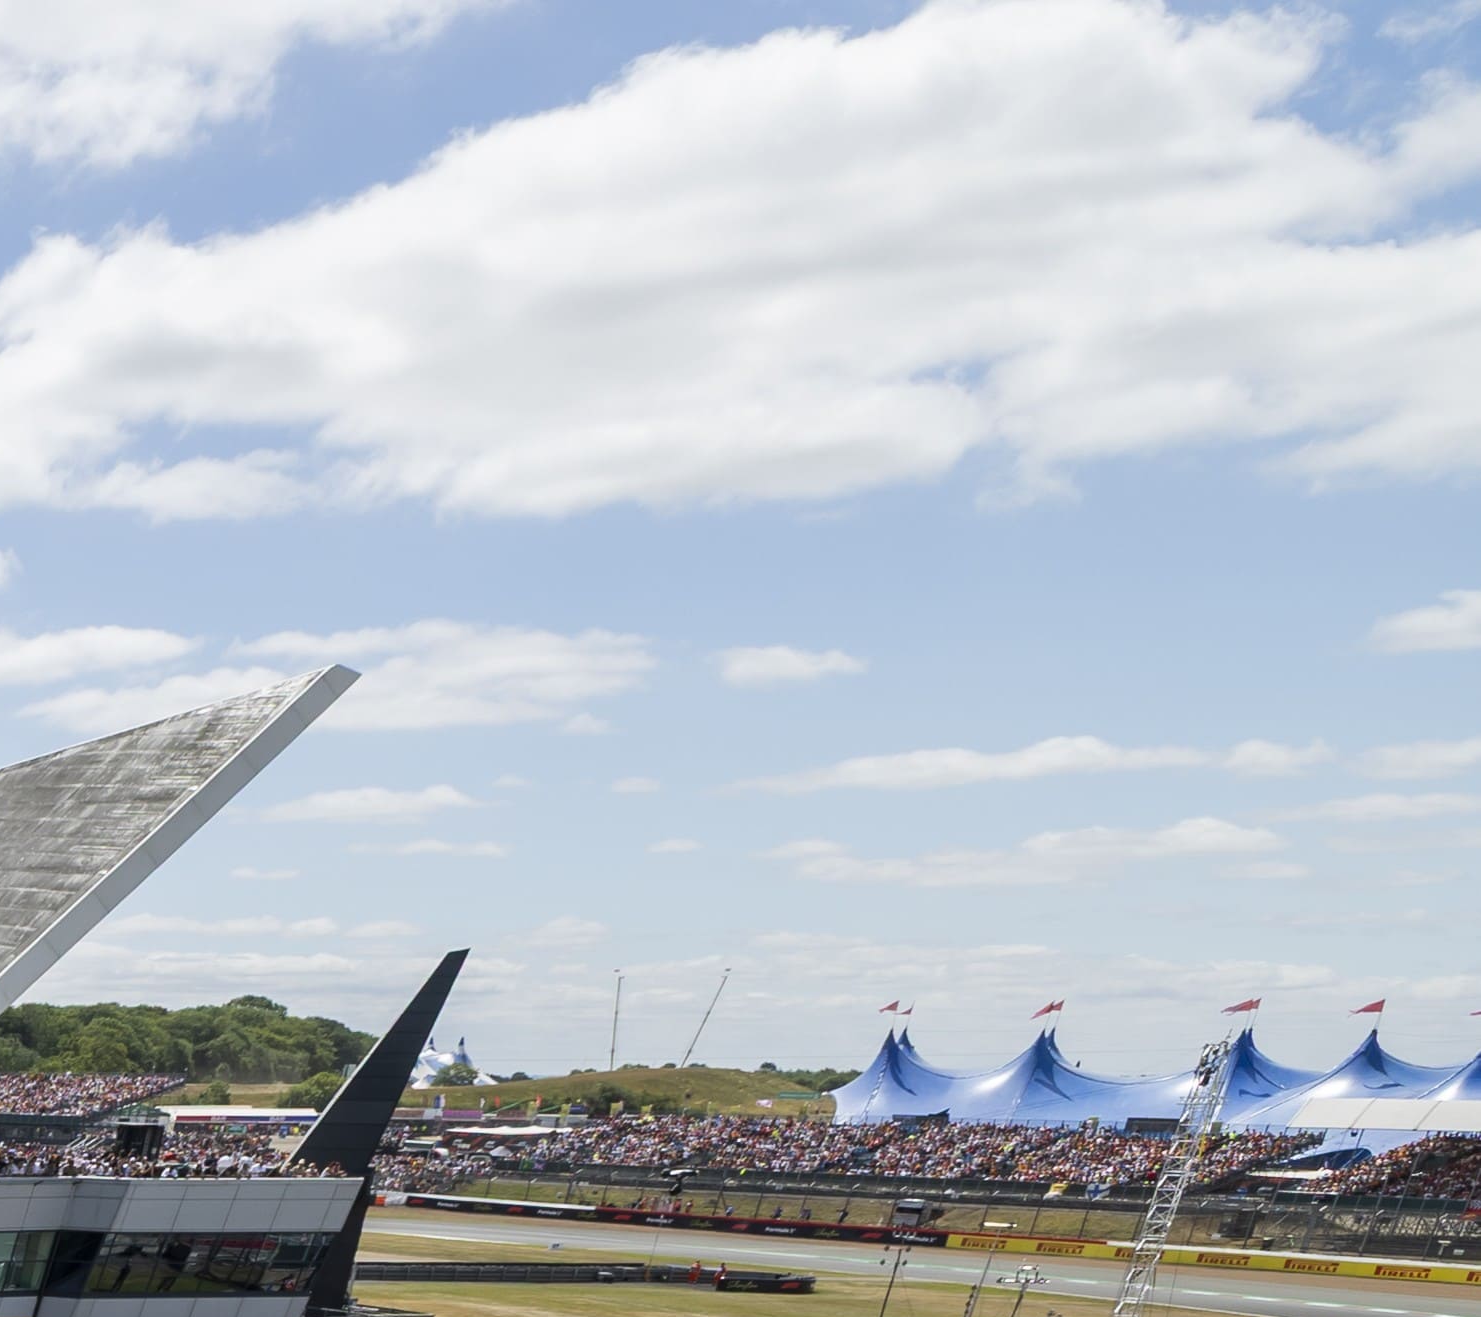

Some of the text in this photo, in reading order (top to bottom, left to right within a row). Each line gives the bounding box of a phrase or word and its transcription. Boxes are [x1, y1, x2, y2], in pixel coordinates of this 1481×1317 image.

[960, 1237, 1007, 1249] PIRELLI
[1036, 1242, 1084, 1254] PIRELLI
[1196, 1253, 1251, 1266] PIRELLI
[1284, 1259, 1340, 1273] PIRELLI
[1374, 1265, 1432, 1279] PIRELLI
